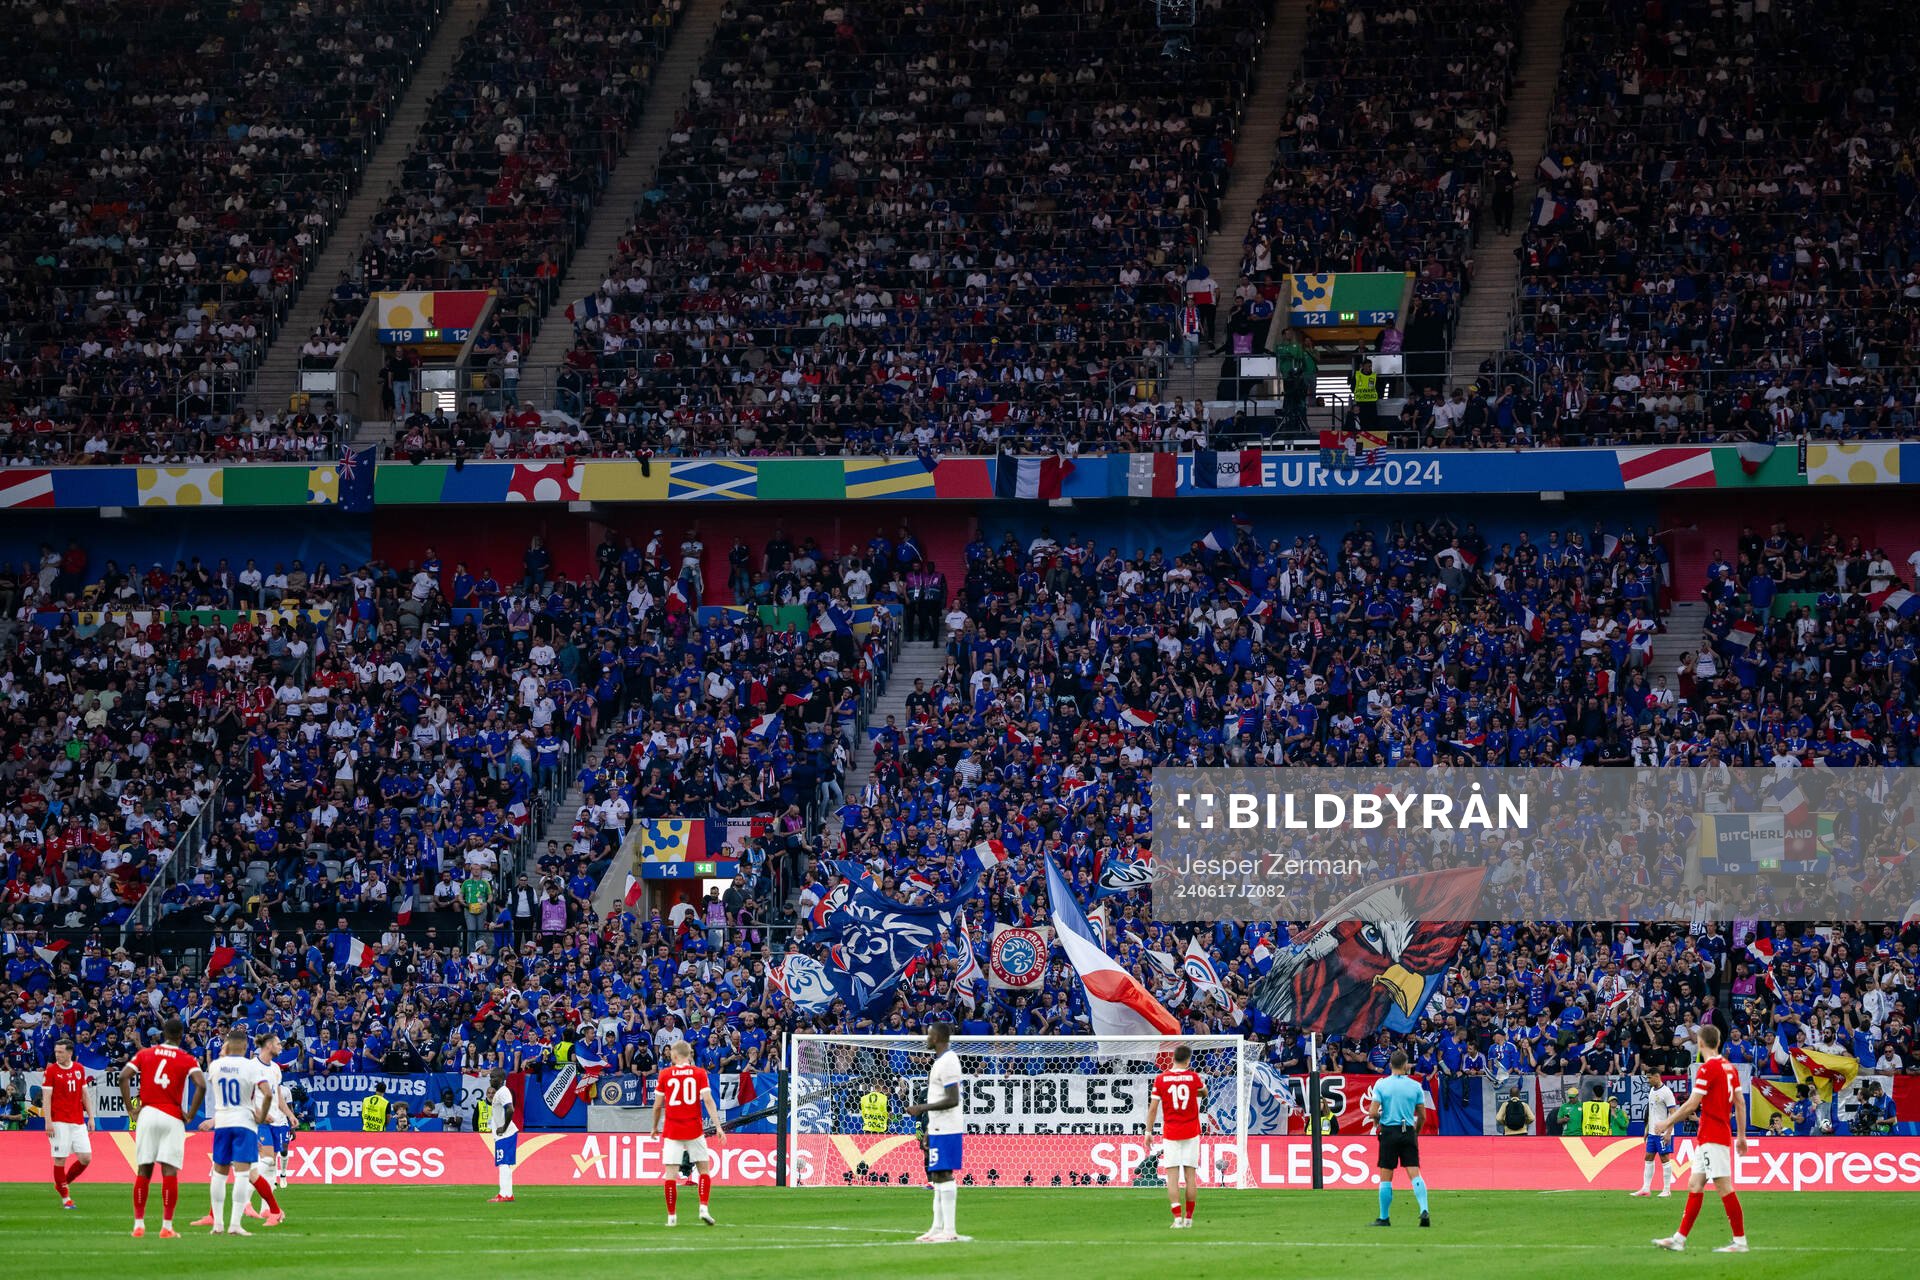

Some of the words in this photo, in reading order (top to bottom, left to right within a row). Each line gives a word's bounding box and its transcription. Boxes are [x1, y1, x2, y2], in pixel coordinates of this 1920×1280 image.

[1303, 313, 1326, 324] 121
[389, 330, 412, 342] 119
[453, 329, 471, 341] 12
[1262, 461, 1360, 487] EURO
[1363, 461, 1443, 486] 2024
[1719, 829, 1813, 842] BITCHERLAND
[659, 864, 678, 877] 14
[1800, 860, 1818, 872] 17
[1003, 973, 1028, 984] 2010
[154, 1058, 171, 1089] 4
[67, 1079, 76, 1093] 11
[218, 1077, 241, 1107] 10
[545, 1063, 577, 1107] STRASBOURG
[667, 1077, 697, 1106] 20
[720, 1081, 739, 1100] 77
[1167, 1083, 1190, 1110] 19
[573, 1135, 814, 1182] AliEpress
[1090, 1143, 1240, 1183] SPND
[1260, 1143, 1381, 1184] LESS.
[1671, 1138, 1920, 1191] AExpress
